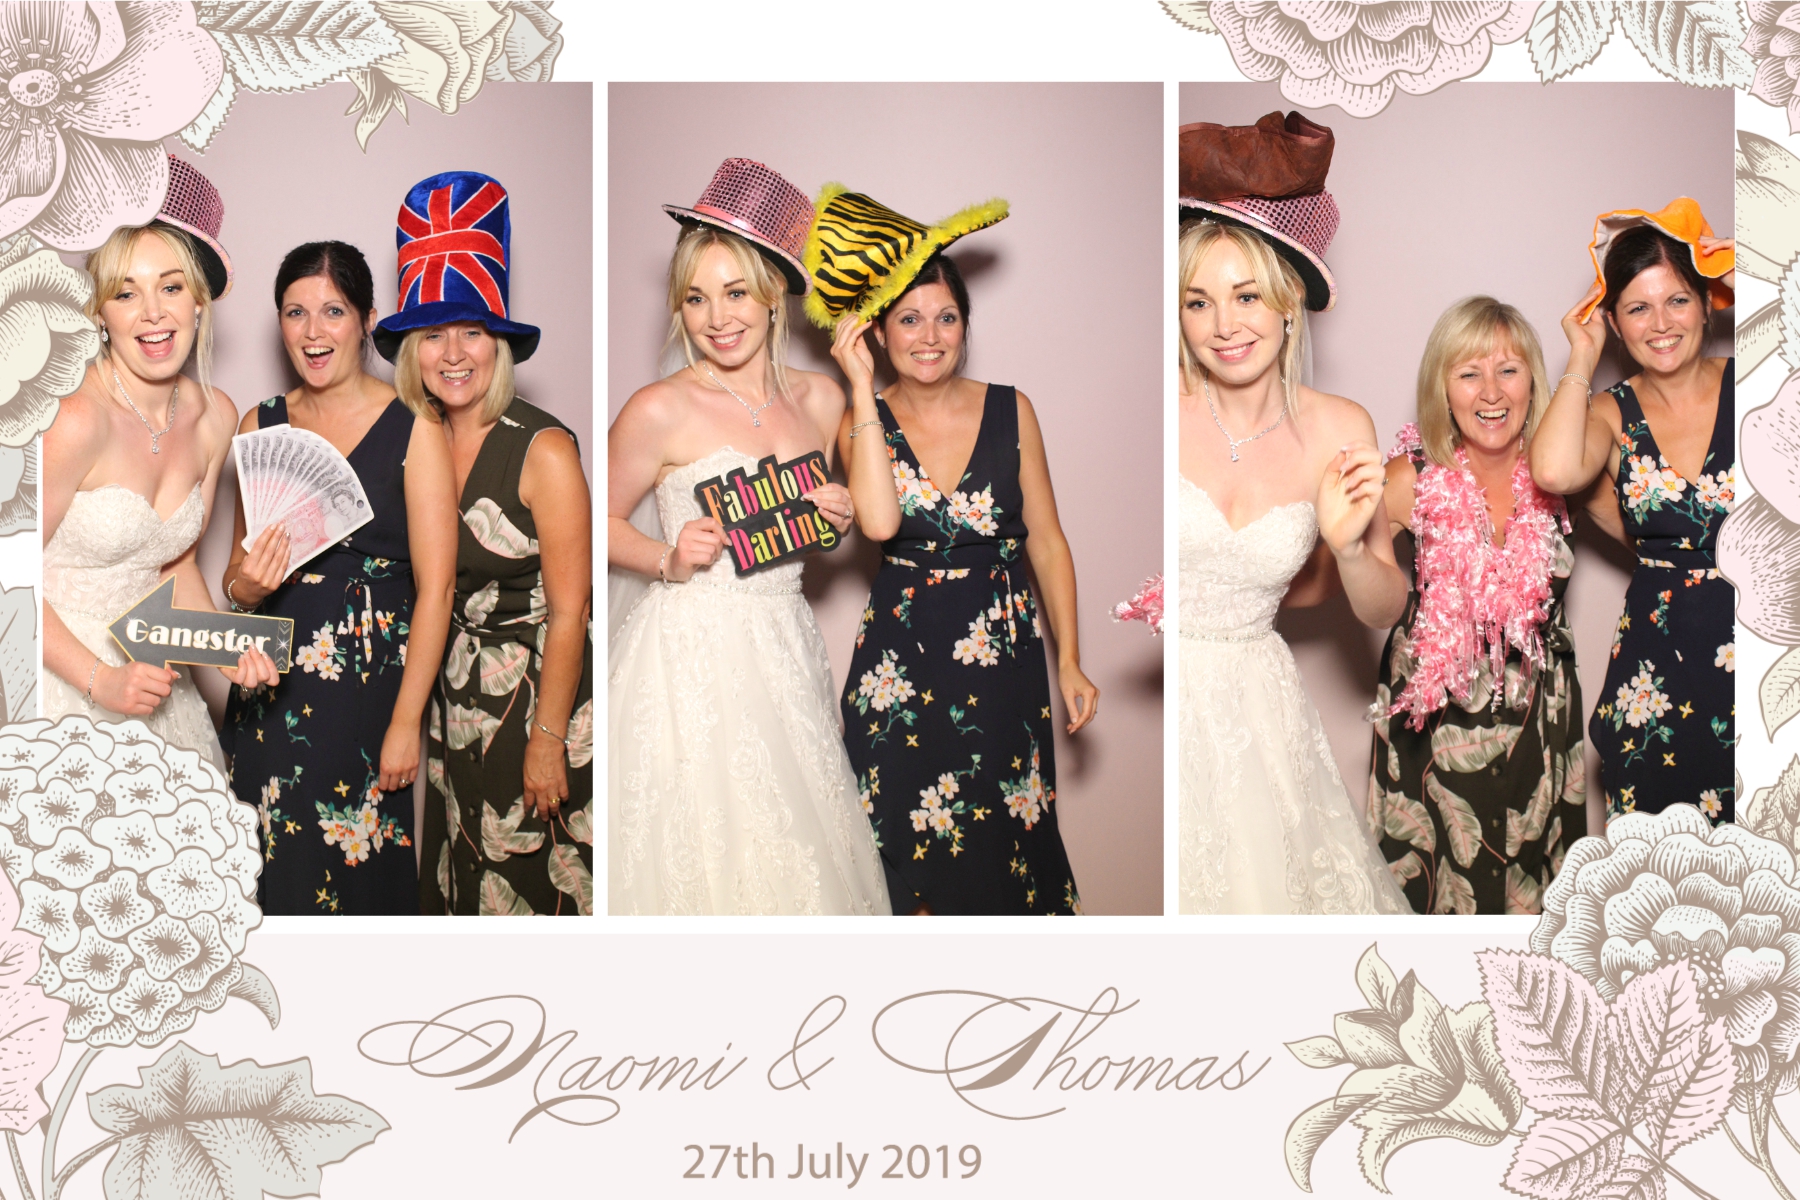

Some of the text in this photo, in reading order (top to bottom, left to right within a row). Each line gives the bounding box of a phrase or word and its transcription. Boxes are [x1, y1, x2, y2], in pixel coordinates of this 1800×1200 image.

[701, 457, 828, 526] Fabulous
[727, 508, 836, 571] Darling
[126, 618, 271, 654] Gangster
